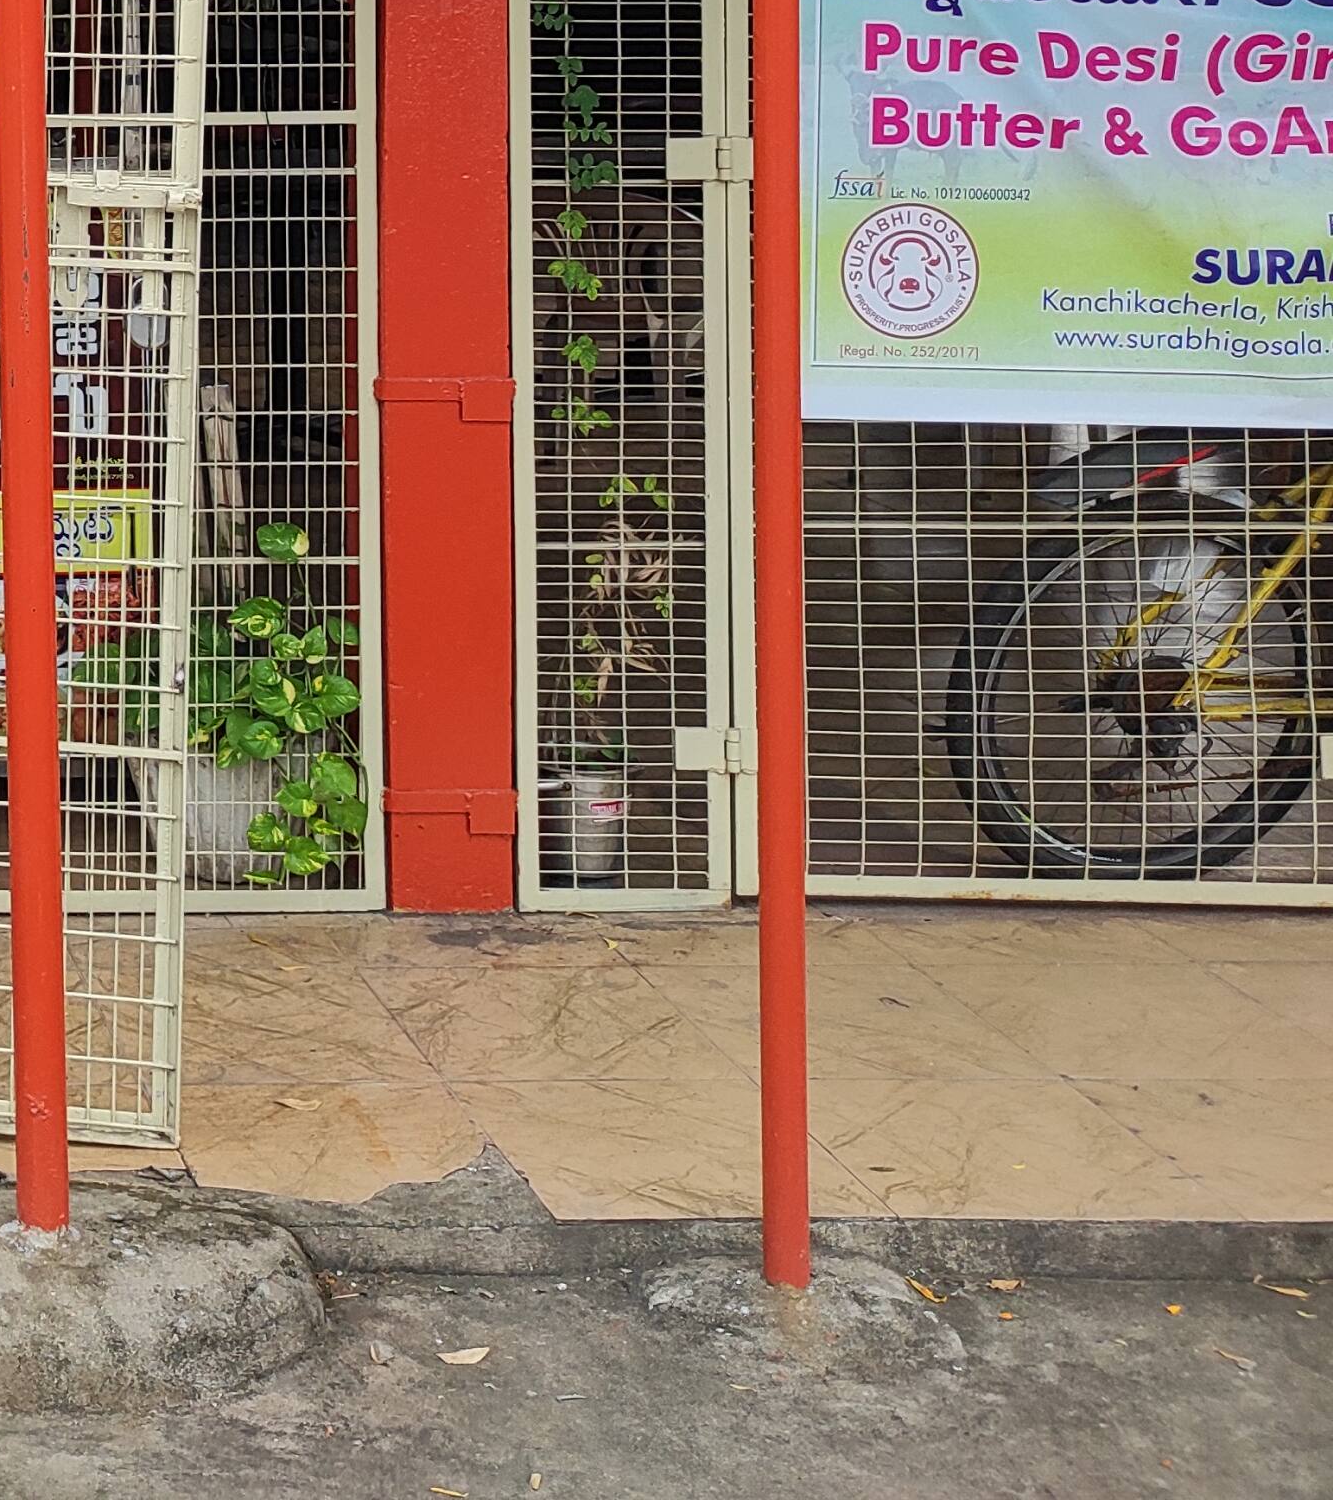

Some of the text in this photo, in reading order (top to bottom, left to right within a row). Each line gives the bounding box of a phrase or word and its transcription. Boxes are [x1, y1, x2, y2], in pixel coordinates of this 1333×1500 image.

[865, 22, 1019, 75] Pure
[1038, 31, 1179, 82] Desi
[872, 97, 1081, 150] Butter
[1104, 107, 1148, 156] &
[829, 169, 885, 200] fssai
[891, 187, 1031, 201] Lic. No. 10121006000342
[848, 210, 973, 285] SURABHI GOSALA
[1191, 249, 1333, 286] SURA
[1042, 288, 1267, 326] Kanchikacherla,
[884, 347, 907, 358] No.
[911, 346, 980, 360] 252/2017]
